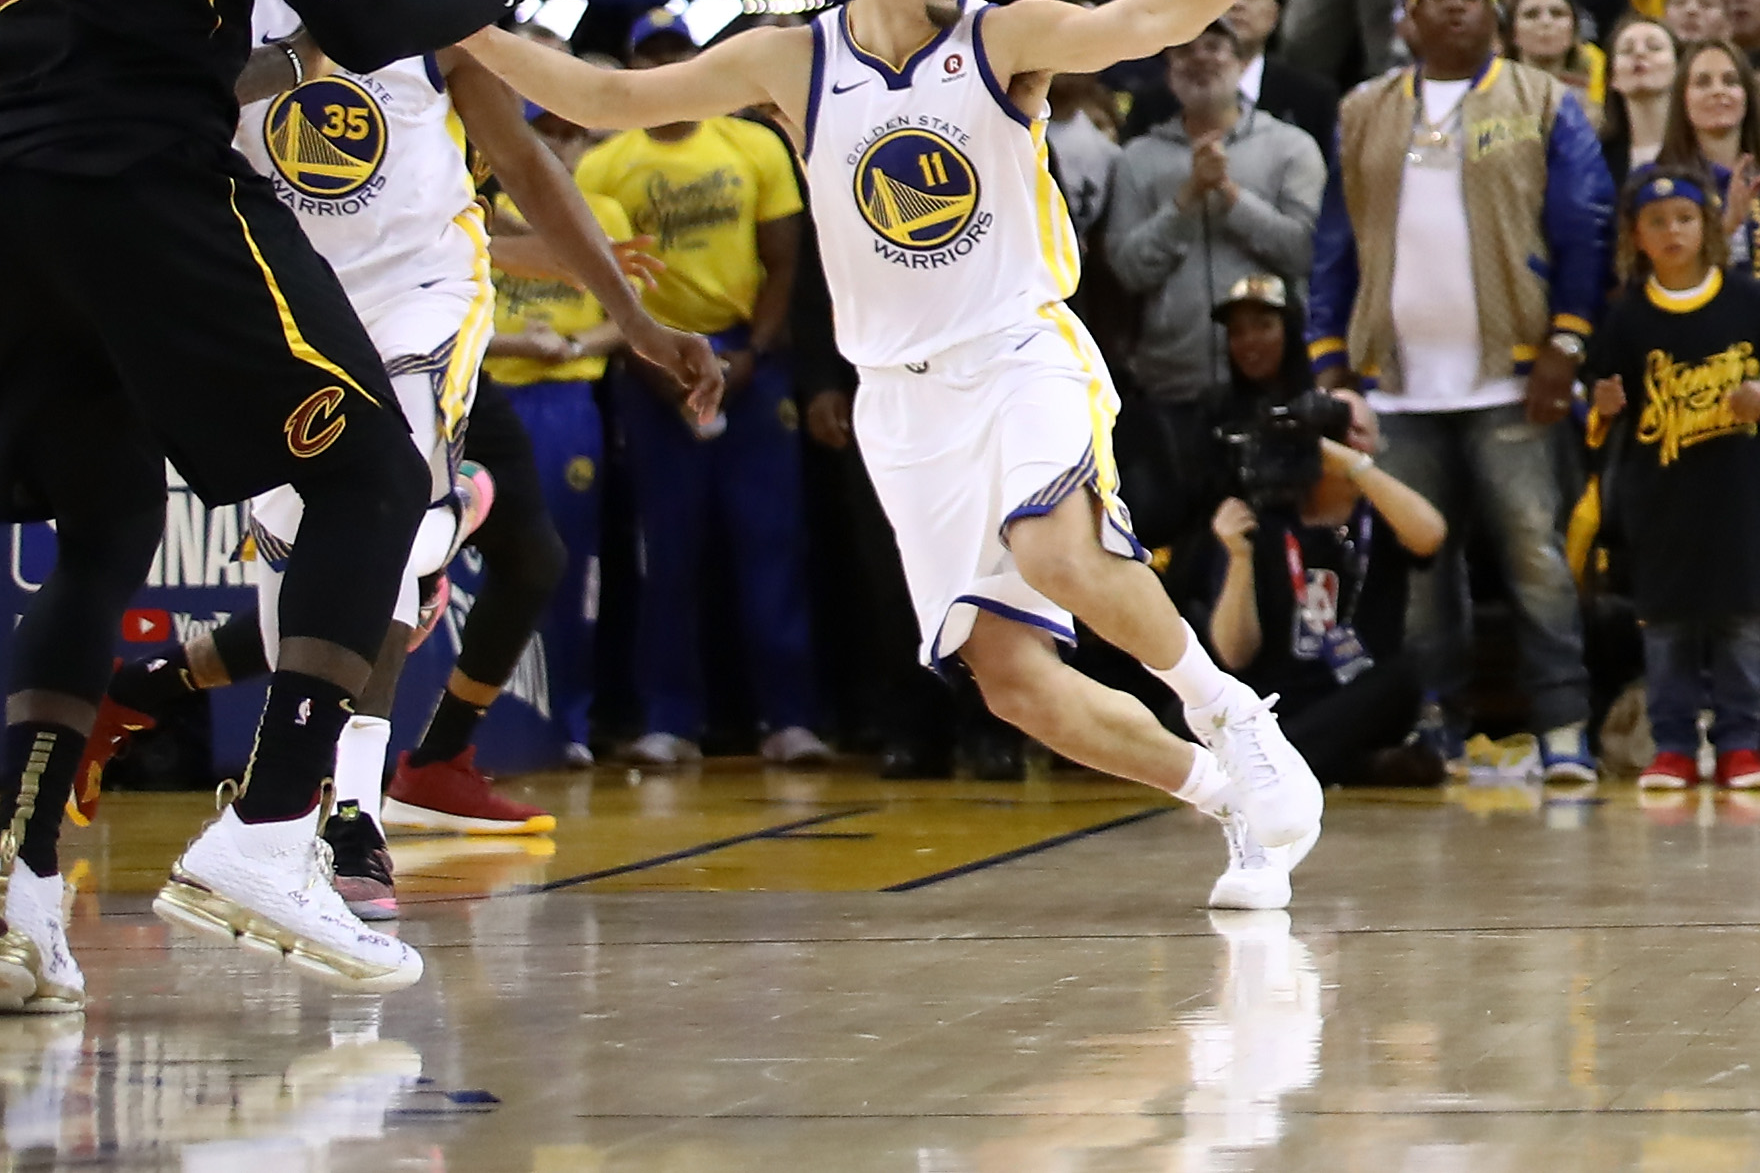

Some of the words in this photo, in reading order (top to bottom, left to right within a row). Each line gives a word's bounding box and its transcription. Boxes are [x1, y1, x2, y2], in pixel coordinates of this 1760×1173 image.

[322, 103, 371, 141] 35
[847, 115, 911, 166] GOLDEN
[918, 114, 971, 147] STATE
[917, 151, 950, 187] 11
[270, 171, 387, 217] WARRIORS
[873, 211, 994, 270] WARRIORS
